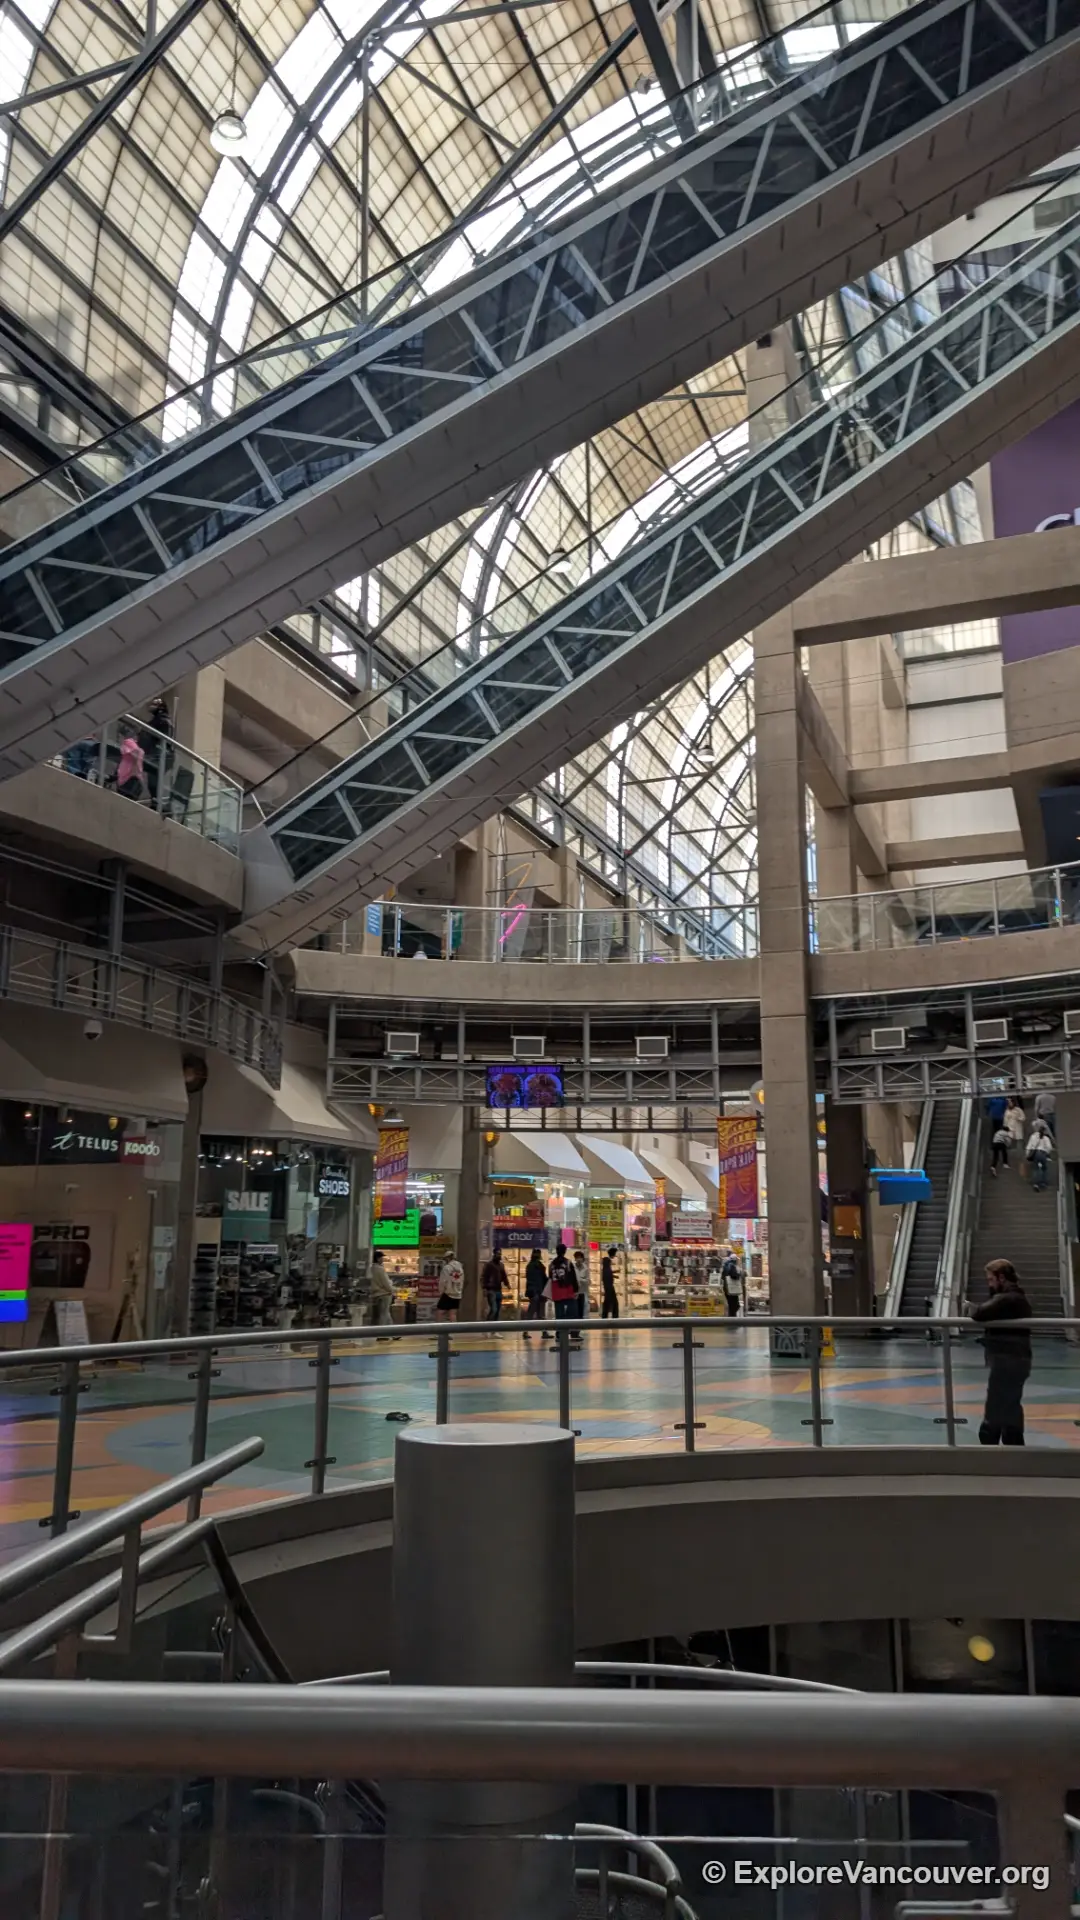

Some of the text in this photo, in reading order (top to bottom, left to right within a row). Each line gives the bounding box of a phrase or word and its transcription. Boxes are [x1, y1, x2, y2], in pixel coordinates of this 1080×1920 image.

[78, 1135, 118, 1152] TELUS
[318, 1179, 350, 1196] SHOES
[227, 1190, 269, 1212] SALE
